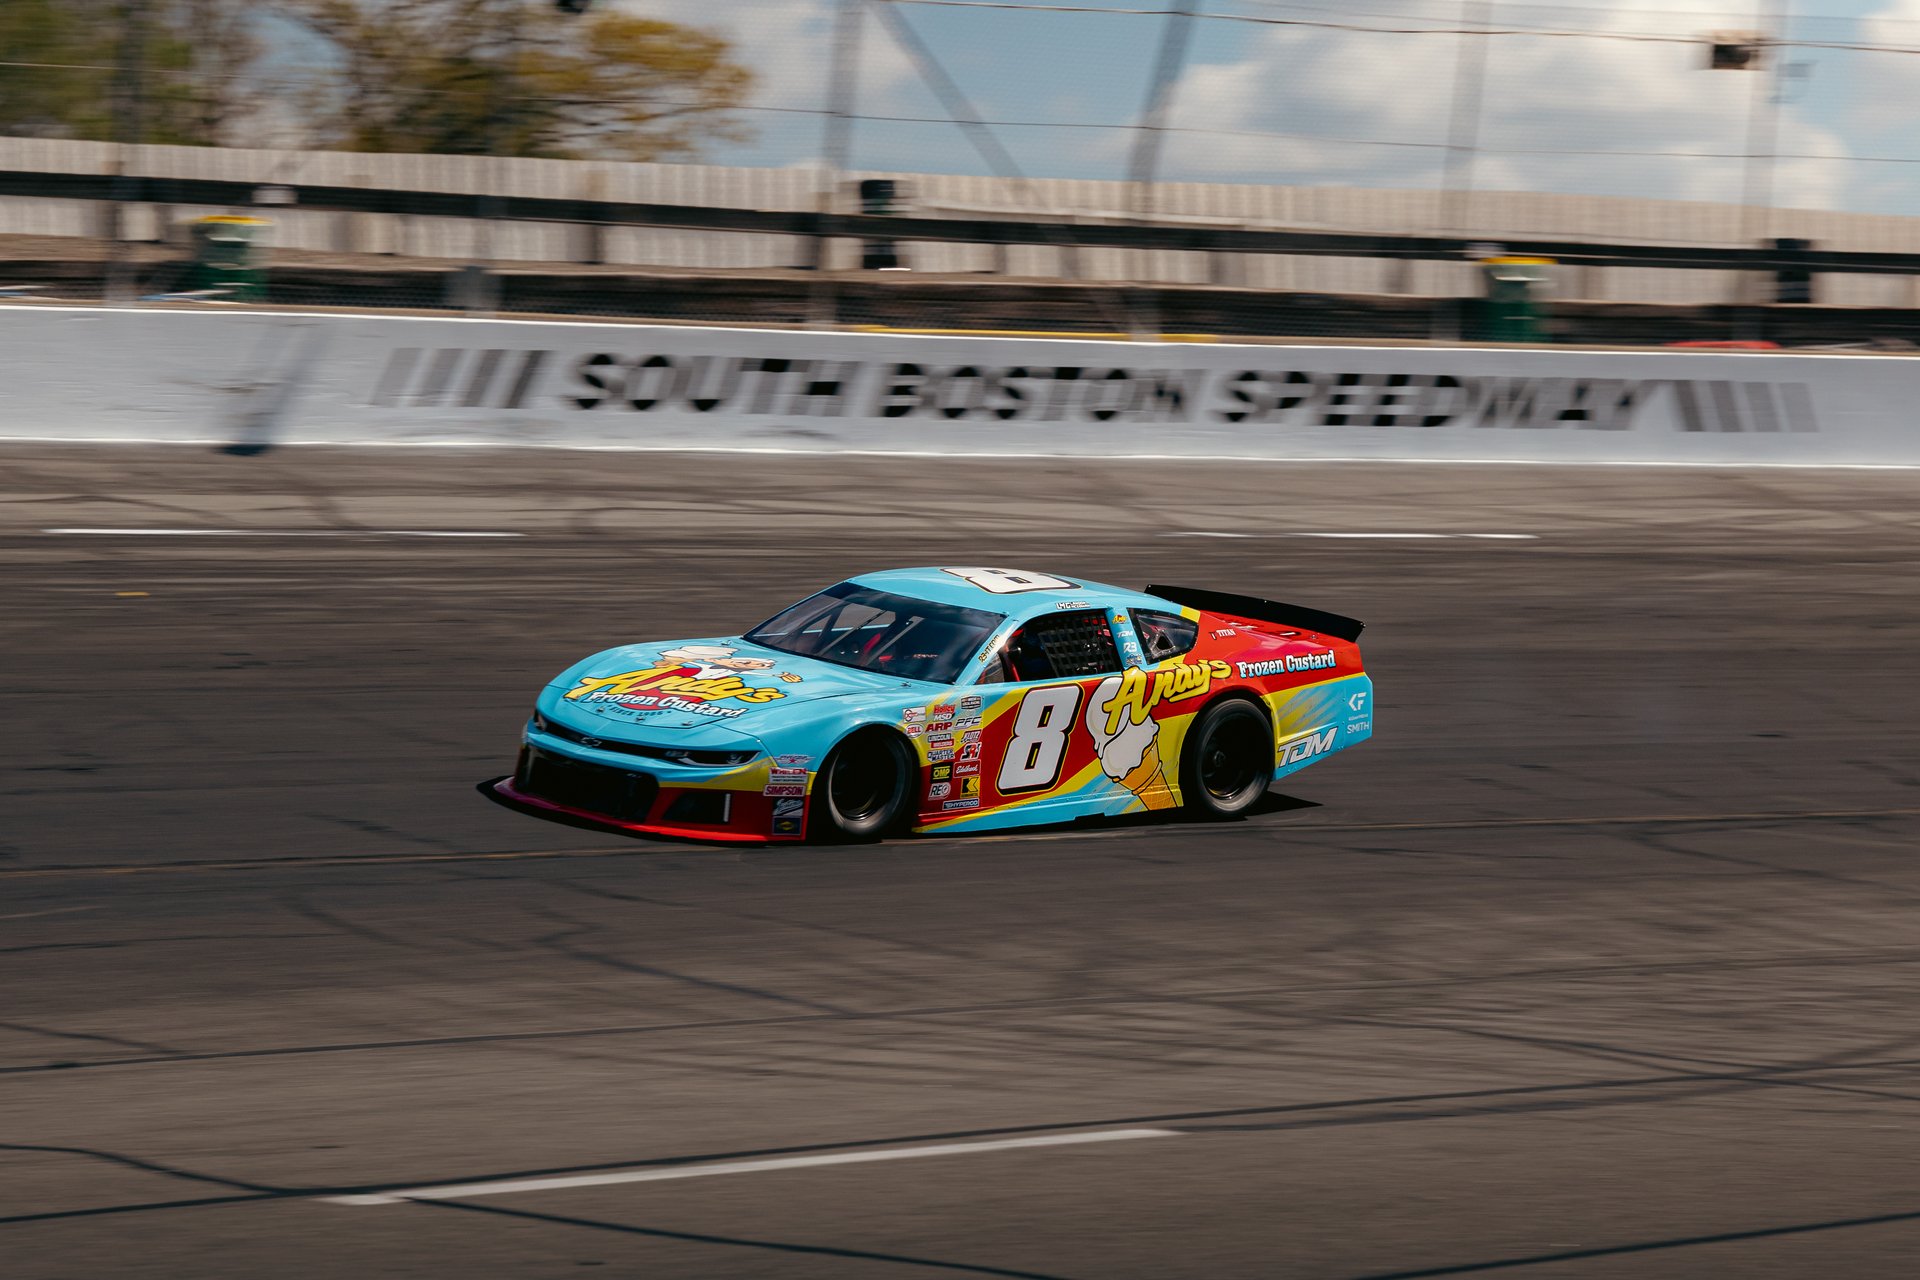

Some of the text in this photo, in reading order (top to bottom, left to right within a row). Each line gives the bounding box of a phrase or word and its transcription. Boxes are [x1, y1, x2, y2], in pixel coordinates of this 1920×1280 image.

[560, 351, 1657, 431] SOUTH BOSTON SPEEDWAY
[1216, 628, 1237, 637] TITAN
[1236, 649, 1337, 678] Frozen Custard
[563, 665, 787, 703] Andy's
[583, 691, 749, 718] Frozen Custard
[1102, 660, 1232, 736] Andy's
[907, 726, 921, 734] BELL
[926, 722, 952, 732] ARP
[955, 716, 982, 728] PFC
[1347, 721, 1370, 734] SMITH
[996, 682, 1085, 796] 8
[1277, 726, 1339, 768] TDM
[933, 768, 950, 778] OMP
[765, 786, 803, 796] SIMPSON
